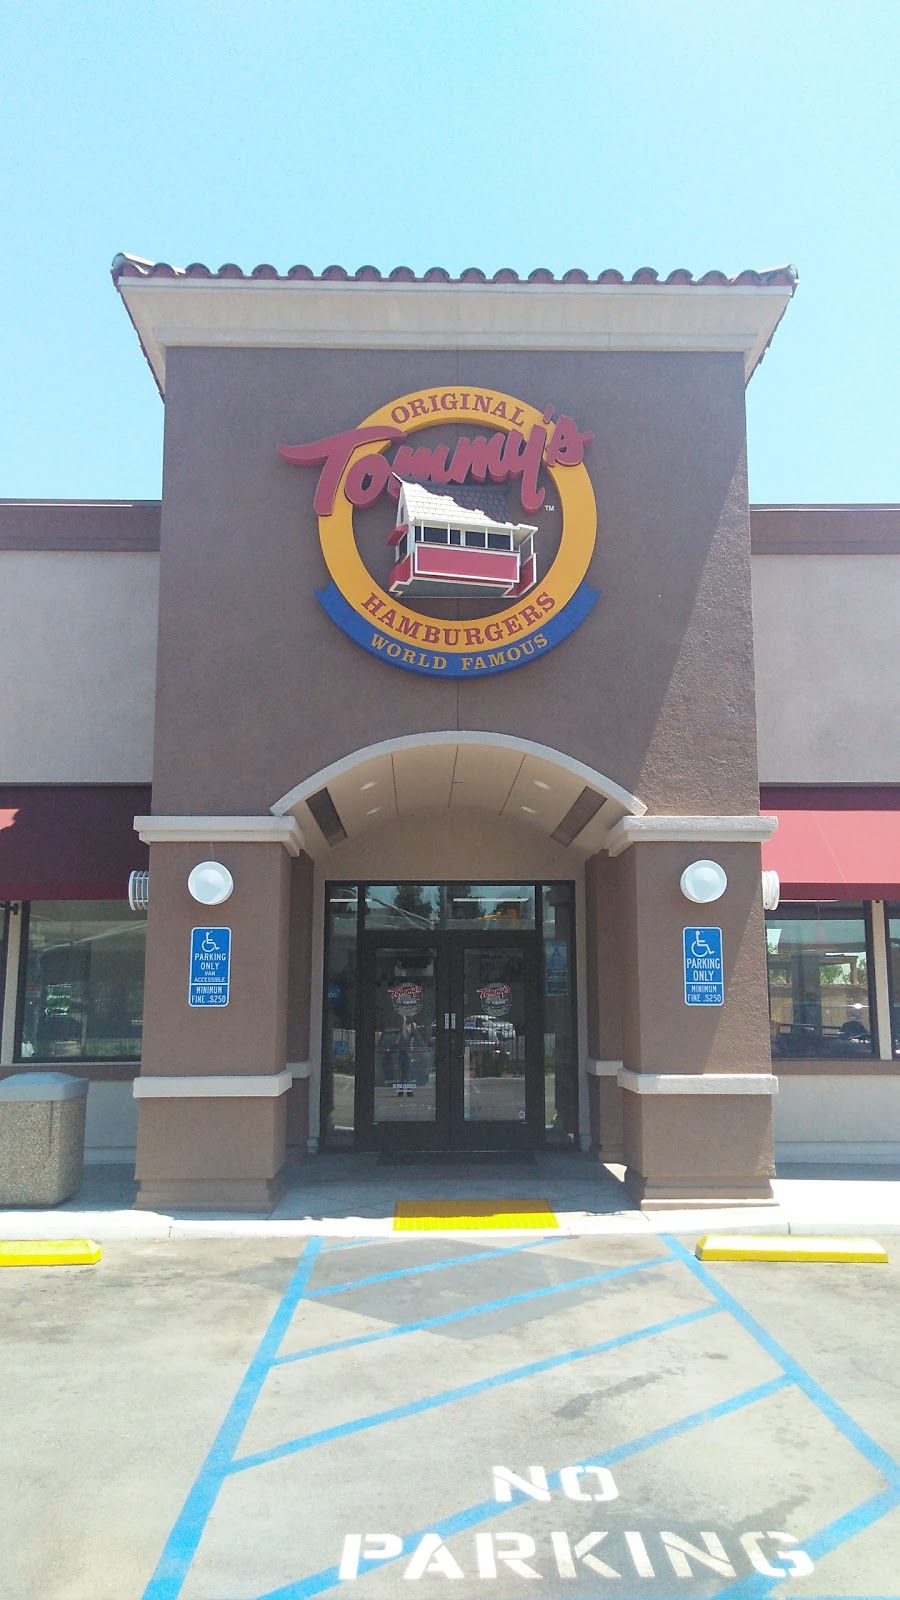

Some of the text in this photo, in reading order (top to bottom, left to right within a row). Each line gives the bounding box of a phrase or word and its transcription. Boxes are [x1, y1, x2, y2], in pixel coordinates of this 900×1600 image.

[391, 393, 526, 427] ORIGINAL
[277, 404, 595, 516] Tommy's
[361, 591, 557, 647] HAMBURGERS
[370, 632, 549, 671] WORLD FAMOUS
[194, 953, 227, 961] PARKING
[200, 962, 220, 970] ONLY
[686, 958, 720, 969] PARKING
[693, 970, 715, 982] ONLY
[196, 986, 223, 994] MINIMUM
[691, 985, 717, 993] MINIMUM
[191, 995, 205, 1003] FINE
[687, 993, 701, 1002] FINE
[492, 1465, 620, 1502] NO
[338, 1531, 815, 1580] PARKING
